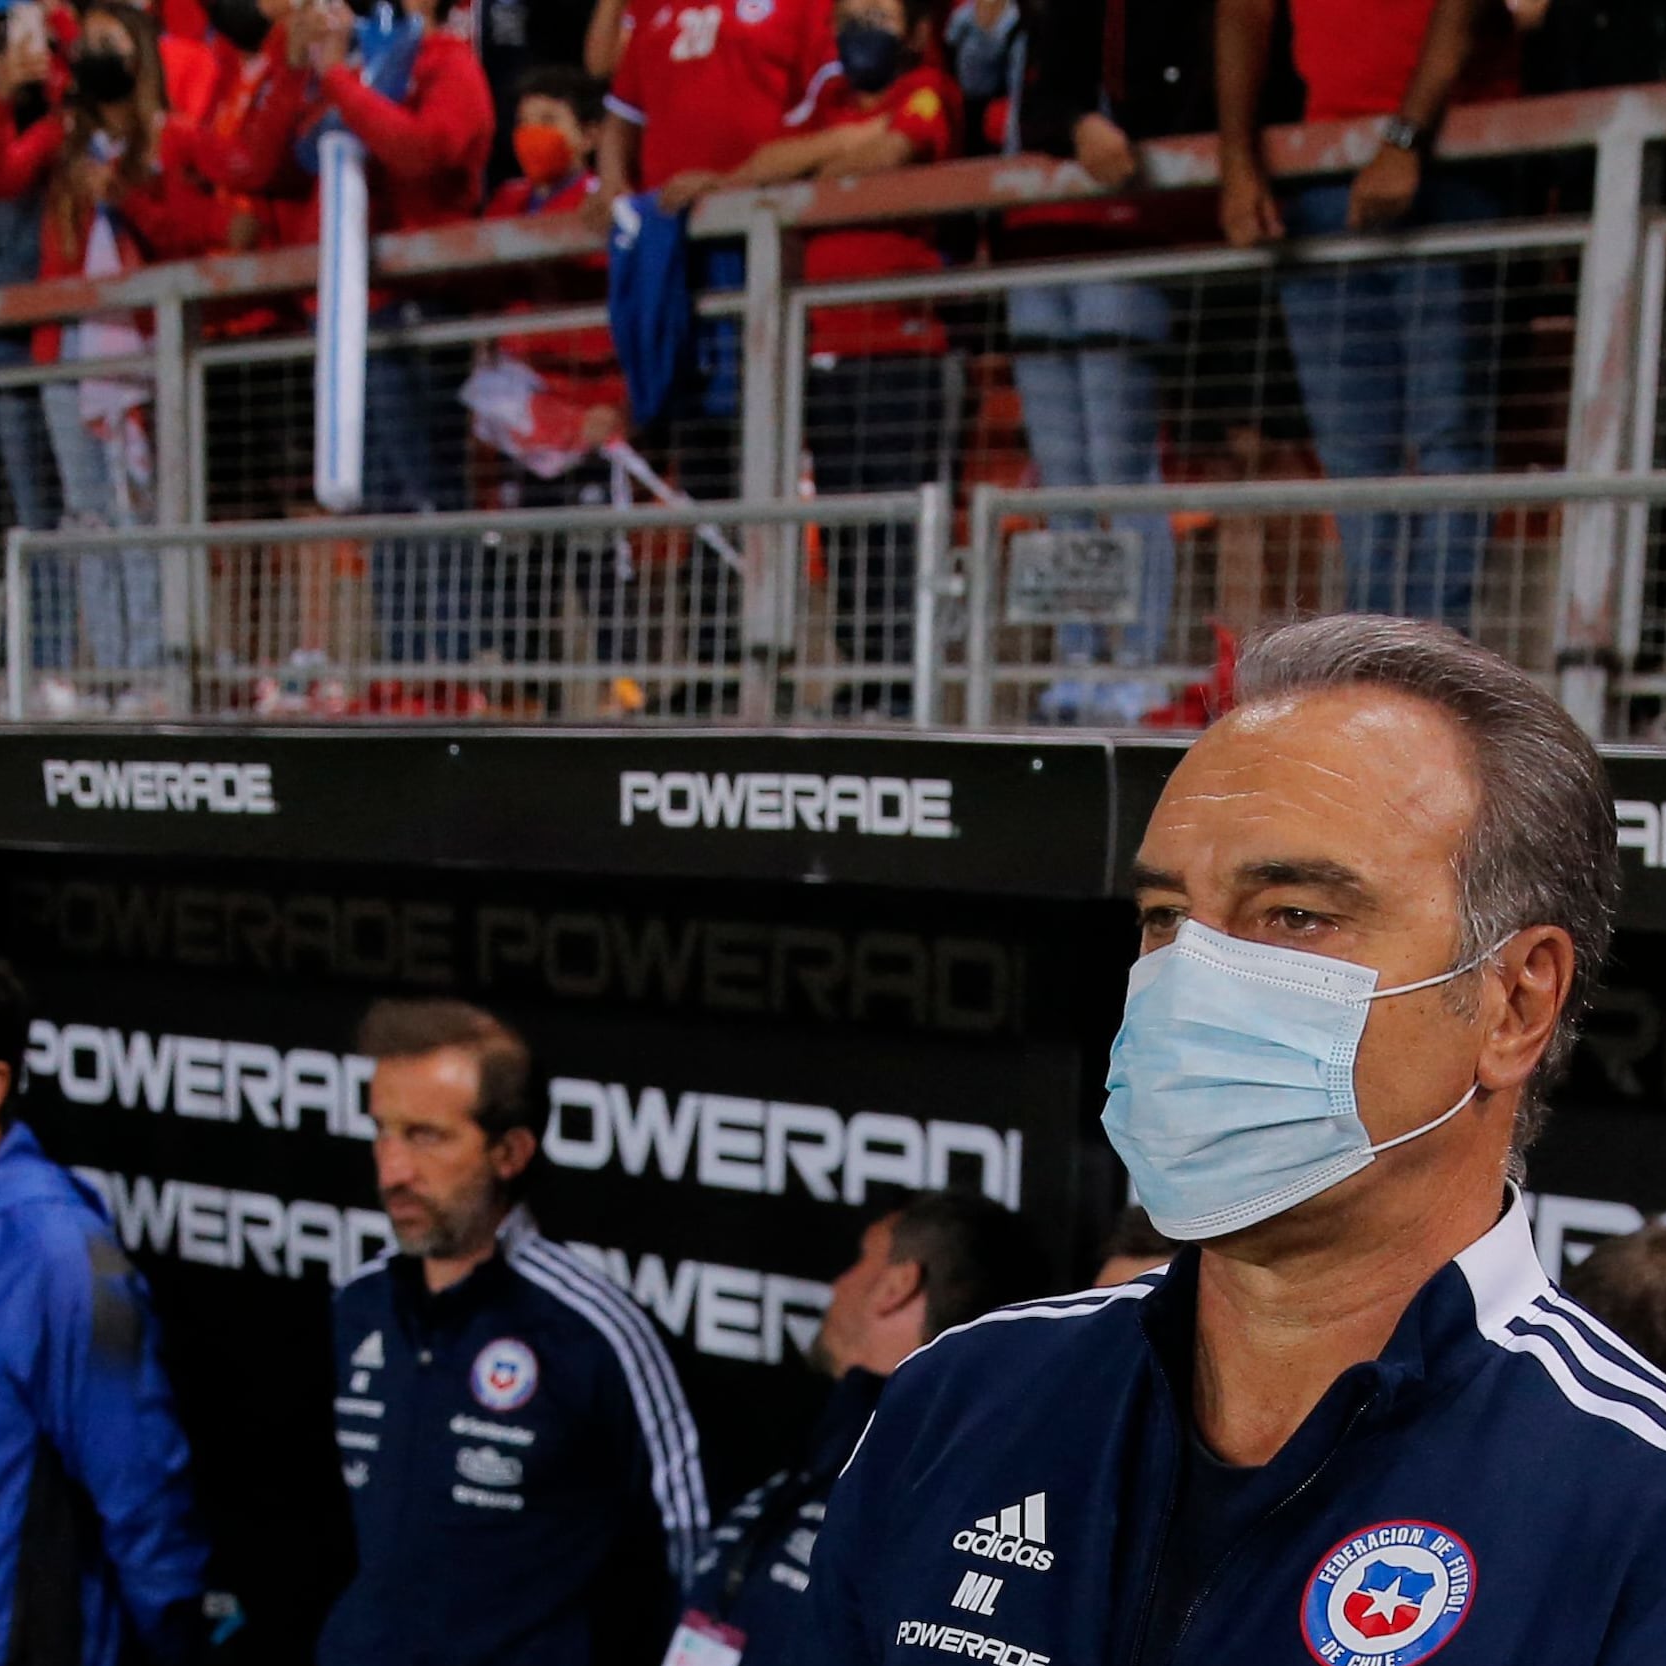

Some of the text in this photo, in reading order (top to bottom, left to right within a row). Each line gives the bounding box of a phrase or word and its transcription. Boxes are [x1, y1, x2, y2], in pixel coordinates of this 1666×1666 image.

[42, 759, 275, 814] POWERADE
[620, 770, 954, 839] POWERADE
[19, 1018, 1023, 1212] POWERAD OWERAD
[952, 1529, 1055, 1571] adidas
[1318, 1527, 1470, 1615] FEDERACION DE FUTBOL
[1319, 1639, 1345, 1664] DE
